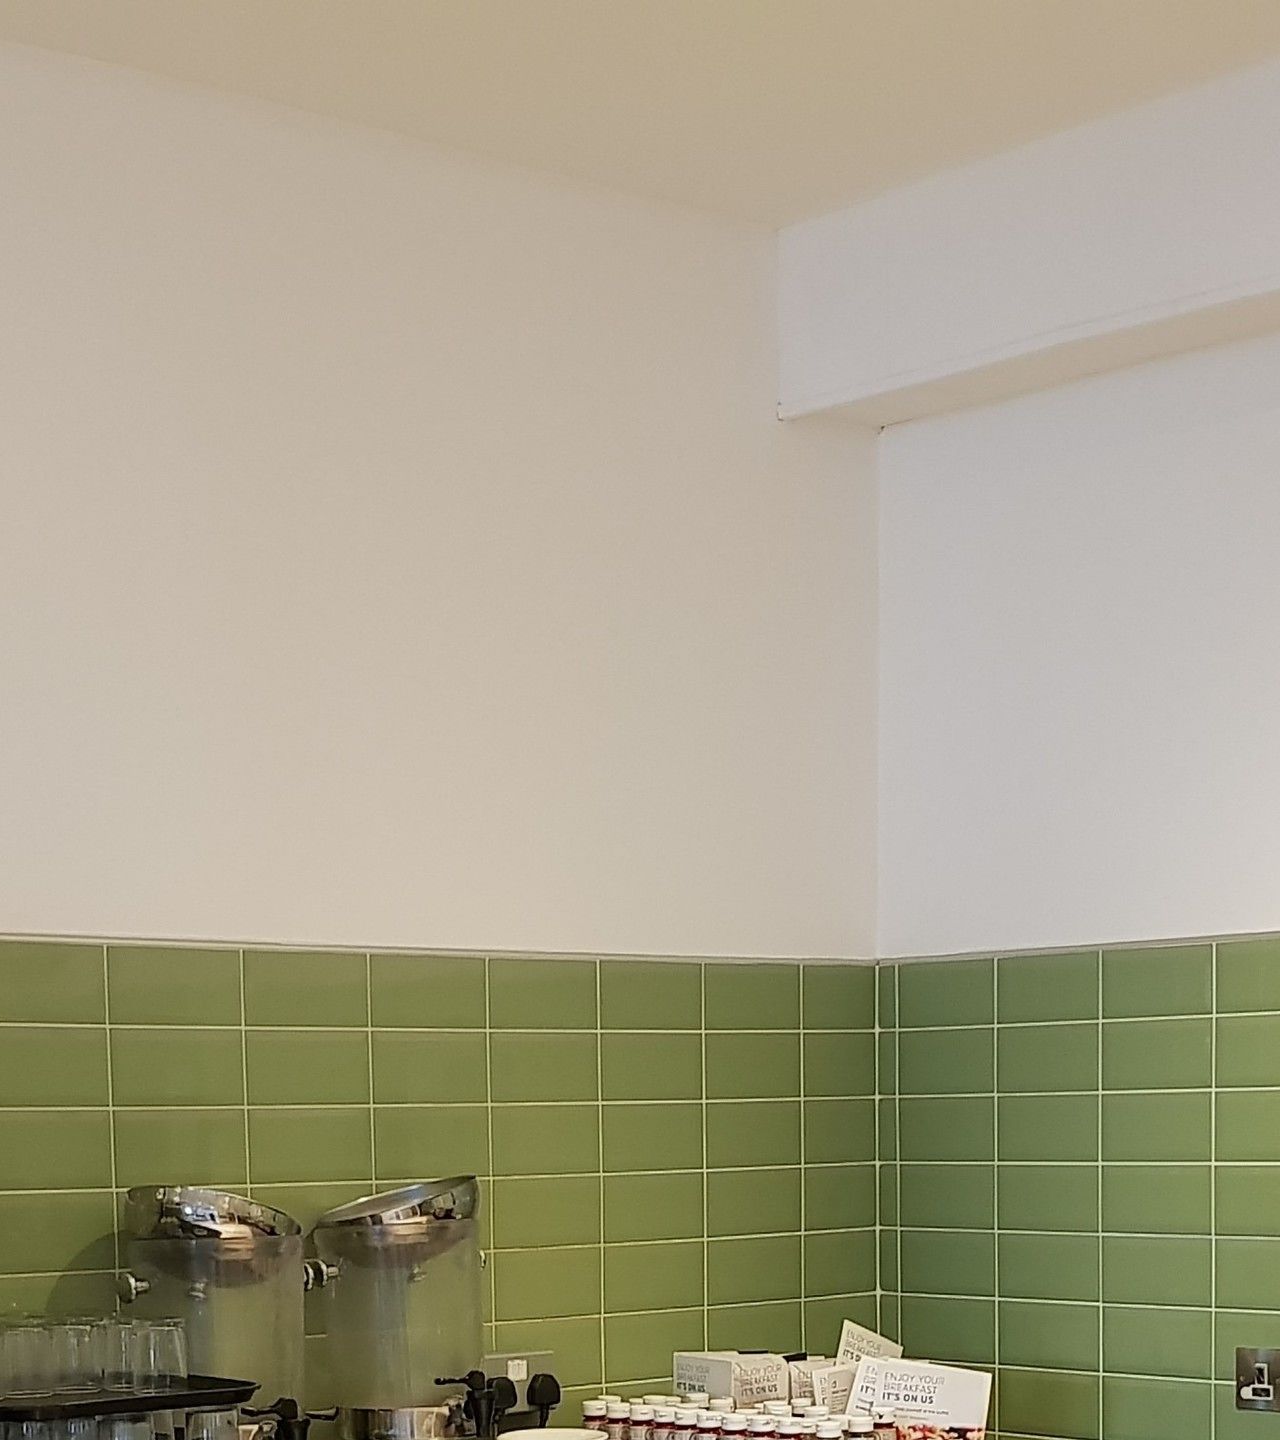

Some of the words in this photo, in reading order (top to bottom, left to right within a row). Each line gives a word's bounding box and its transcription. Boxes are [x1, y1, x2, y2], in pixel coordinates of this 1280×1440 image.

[884, 1372, 915, 1382] ENJOY
[919, 1375, 945, 1385] YOUR
[755, 1386, 766, 1394] ON
[767, 1384, 778, 1393] US
[884, 1382, 937, 1394] BREAKFAST
[882, 1392, 900, 1401] IT'S
[903, 1394, 918, 1403] ON
[921, 1395, 934, 1404] US
